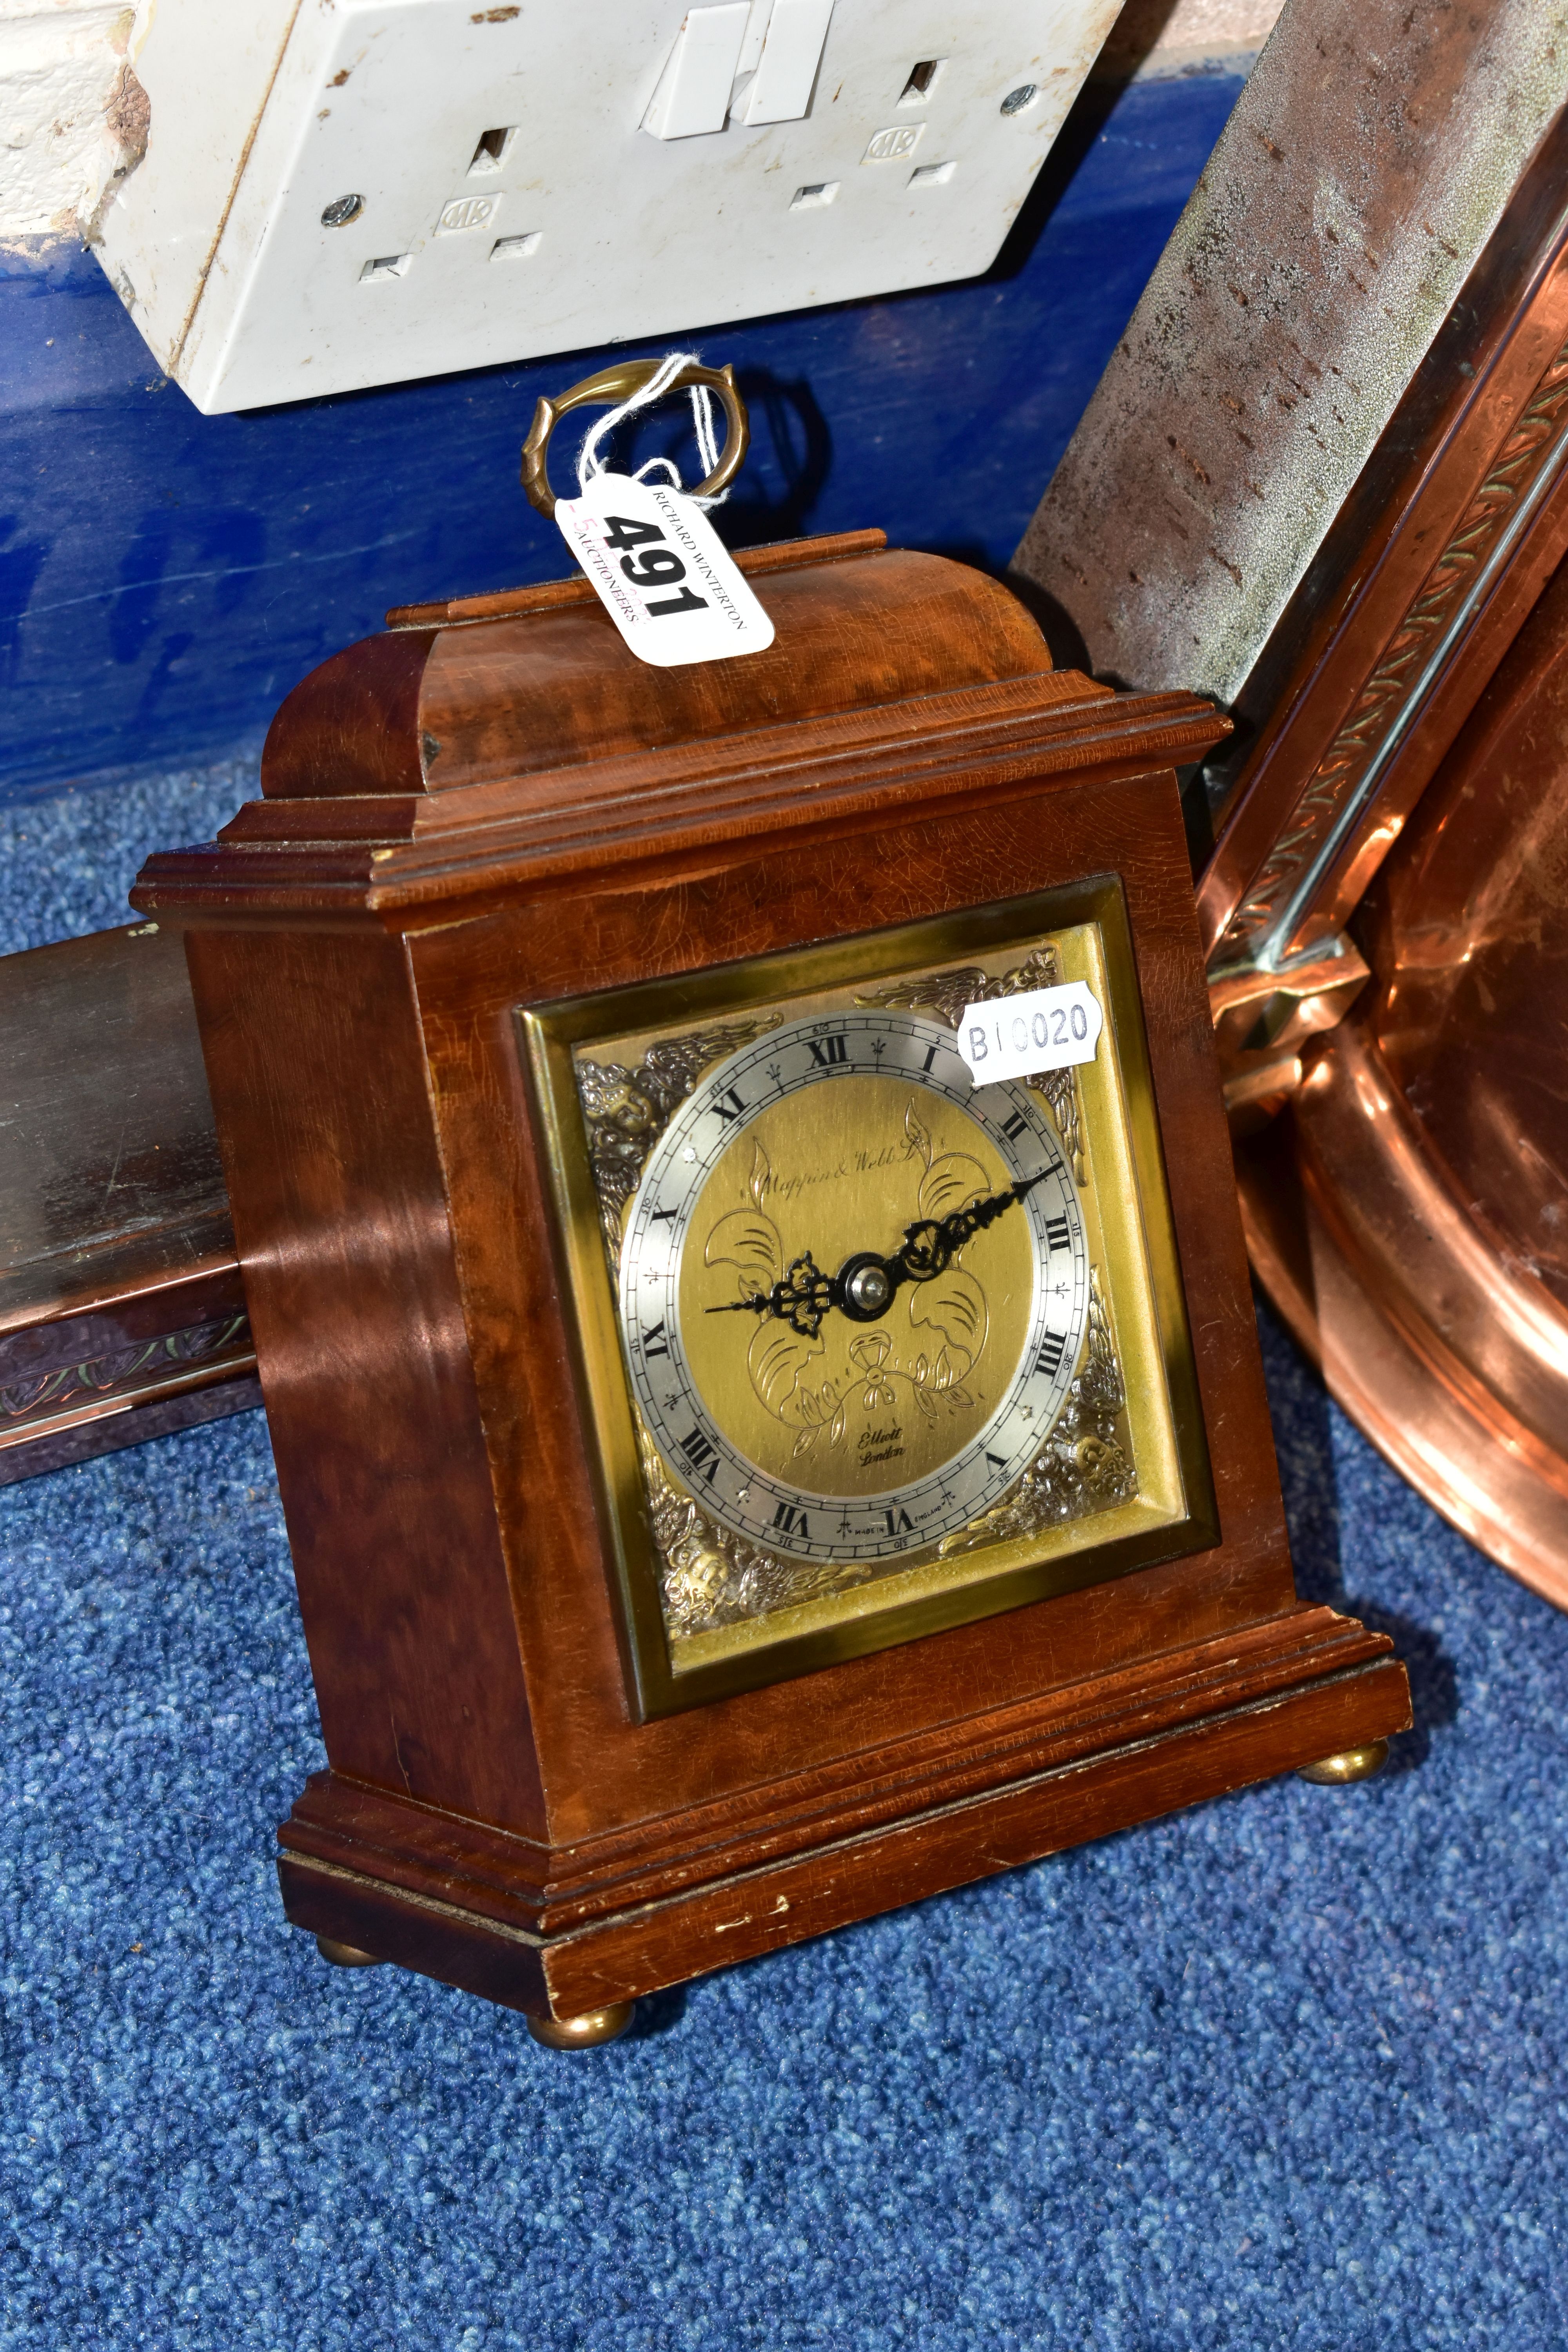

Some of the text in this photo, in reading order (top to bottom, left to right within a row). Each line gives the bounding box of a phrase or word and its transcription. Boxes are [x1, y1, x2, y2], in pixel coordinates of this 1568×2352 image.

[442, 198, 492, 229] MK
[574, 531, 639, 622] AUCTIONEERS
[603, 516, 710, 617] 491
[652, 492, 747, 630] RICHARD WINTERTON
[802, 1034, 853, 1071] XII
[918, 1044, 941, 1075] I
[705, 1083, 751, 1135] XI
[997, 1105, 1031, 1146] II
[833, 1163, 848, 1179] &
[855, 1147, 896, 1172] Webb
[649, 1196, 681, 1235] X
[1044, 1209, 1072, 1259] III
[640, 1314, 671, 1364] IX
[1031, 1325, 1067, 1386] IIII
[676, 1423, 720, 1487] VIII
[858, 1427, 902, 1450] Elliott
[859, 1447, 906, 1467] London
[985, 1451, 1011, 1482] V
[767, 1500, 813, 1539] VII
[855, 1527, 875, 1535] MADE
[914, 1505, 941, 1523] ENGLAND
[879, 1508, 918, 1538] VI
